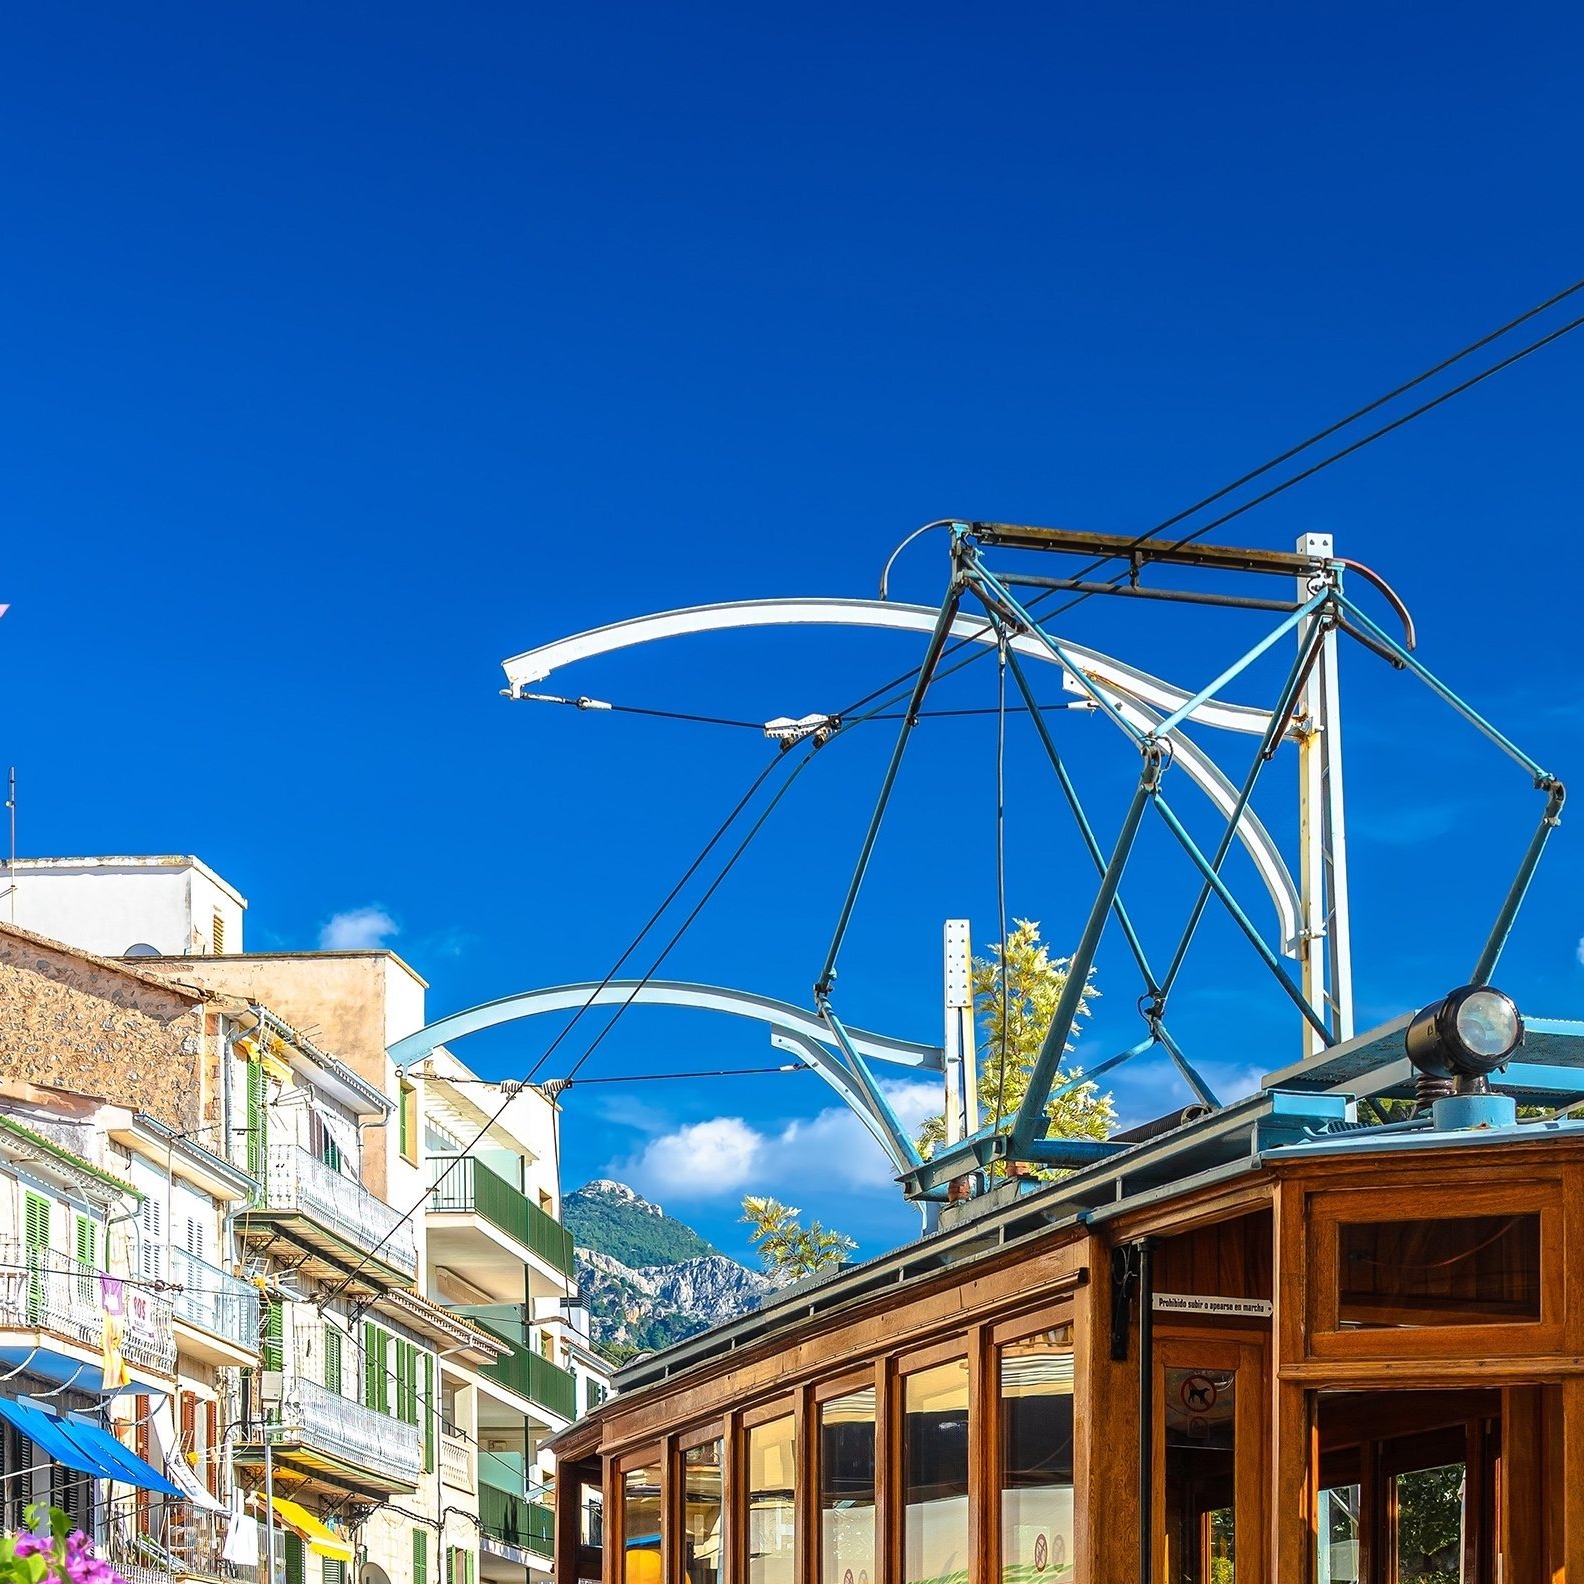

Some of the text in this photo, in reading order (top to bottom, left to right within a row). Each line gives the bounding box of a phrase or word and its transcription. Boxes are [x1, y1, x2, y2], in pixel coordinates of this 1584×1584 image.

[1158, 1297, 1264, 1312] Prohibido subir o apearse en marcha
